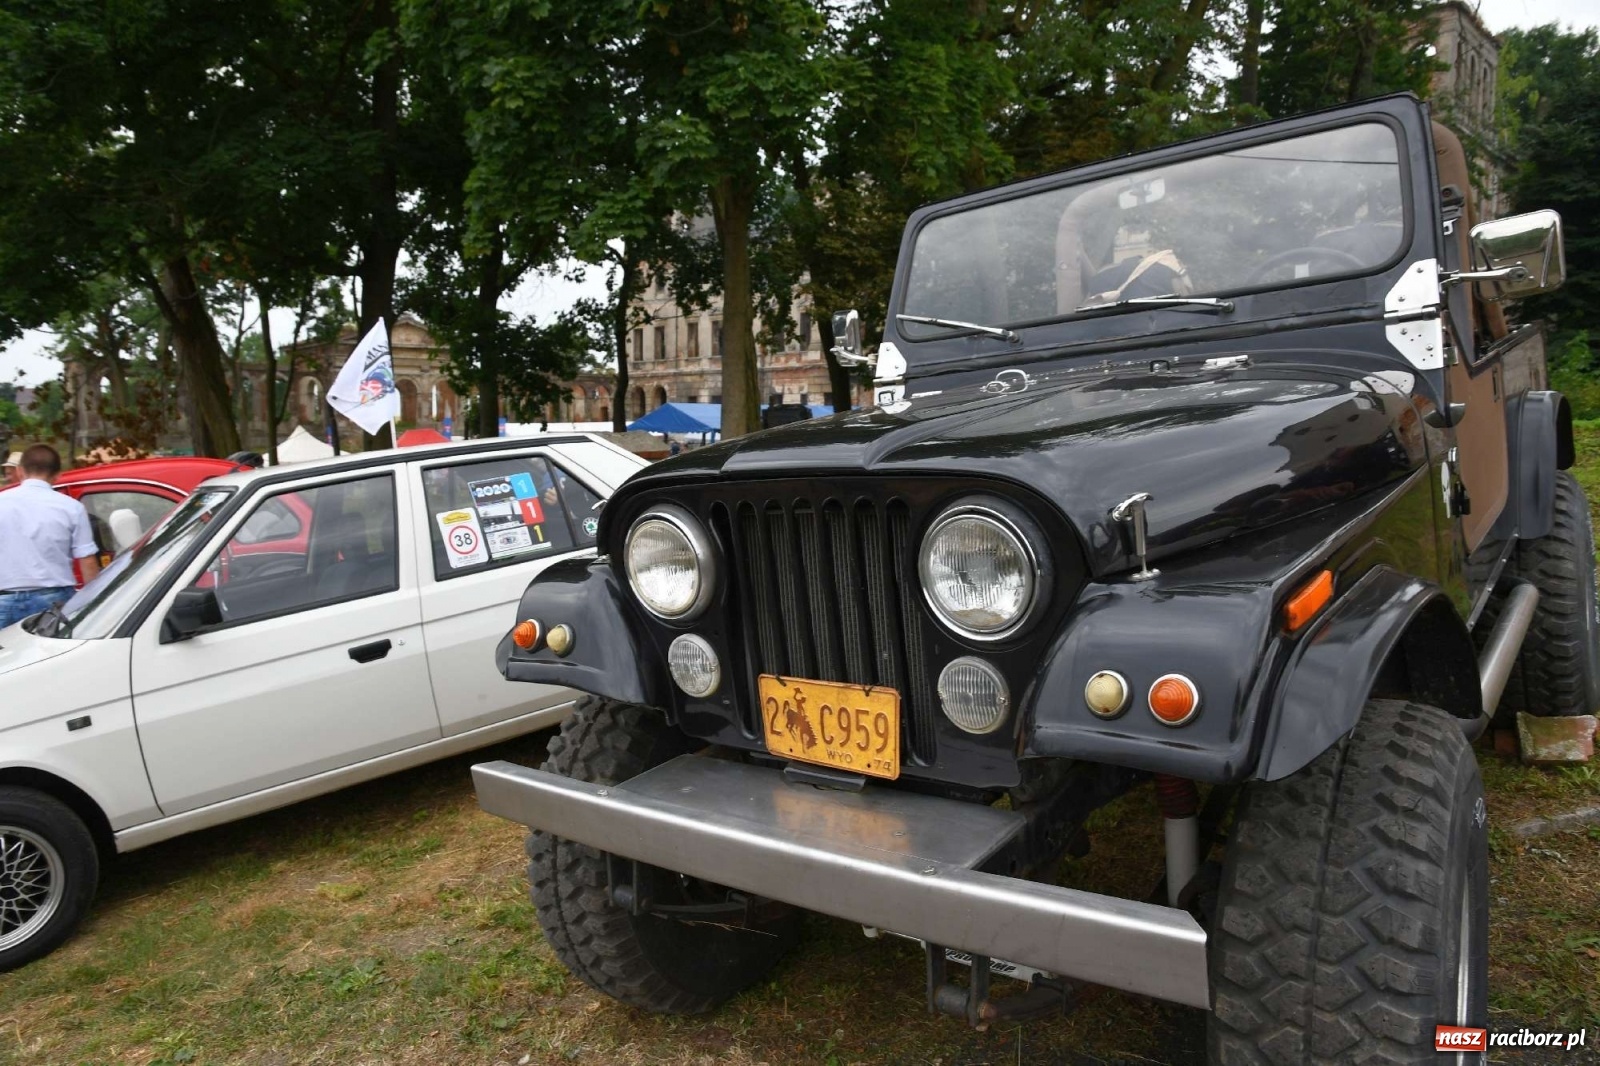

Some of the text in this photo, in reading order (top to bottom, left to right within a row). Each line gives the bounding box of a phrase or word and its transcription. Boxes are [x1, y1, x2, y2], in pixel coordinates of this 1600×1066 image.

[476, 483, 510, 497] 2020
[517, 480, 528, 493] 1
[526, 501, 537, 519] 1
[454, 532, 473, 547] 38
[533, 524, 544, 542] 1
[766, 697, 889, 753] 2 C959
[826, 748, 853, 763] WYO
